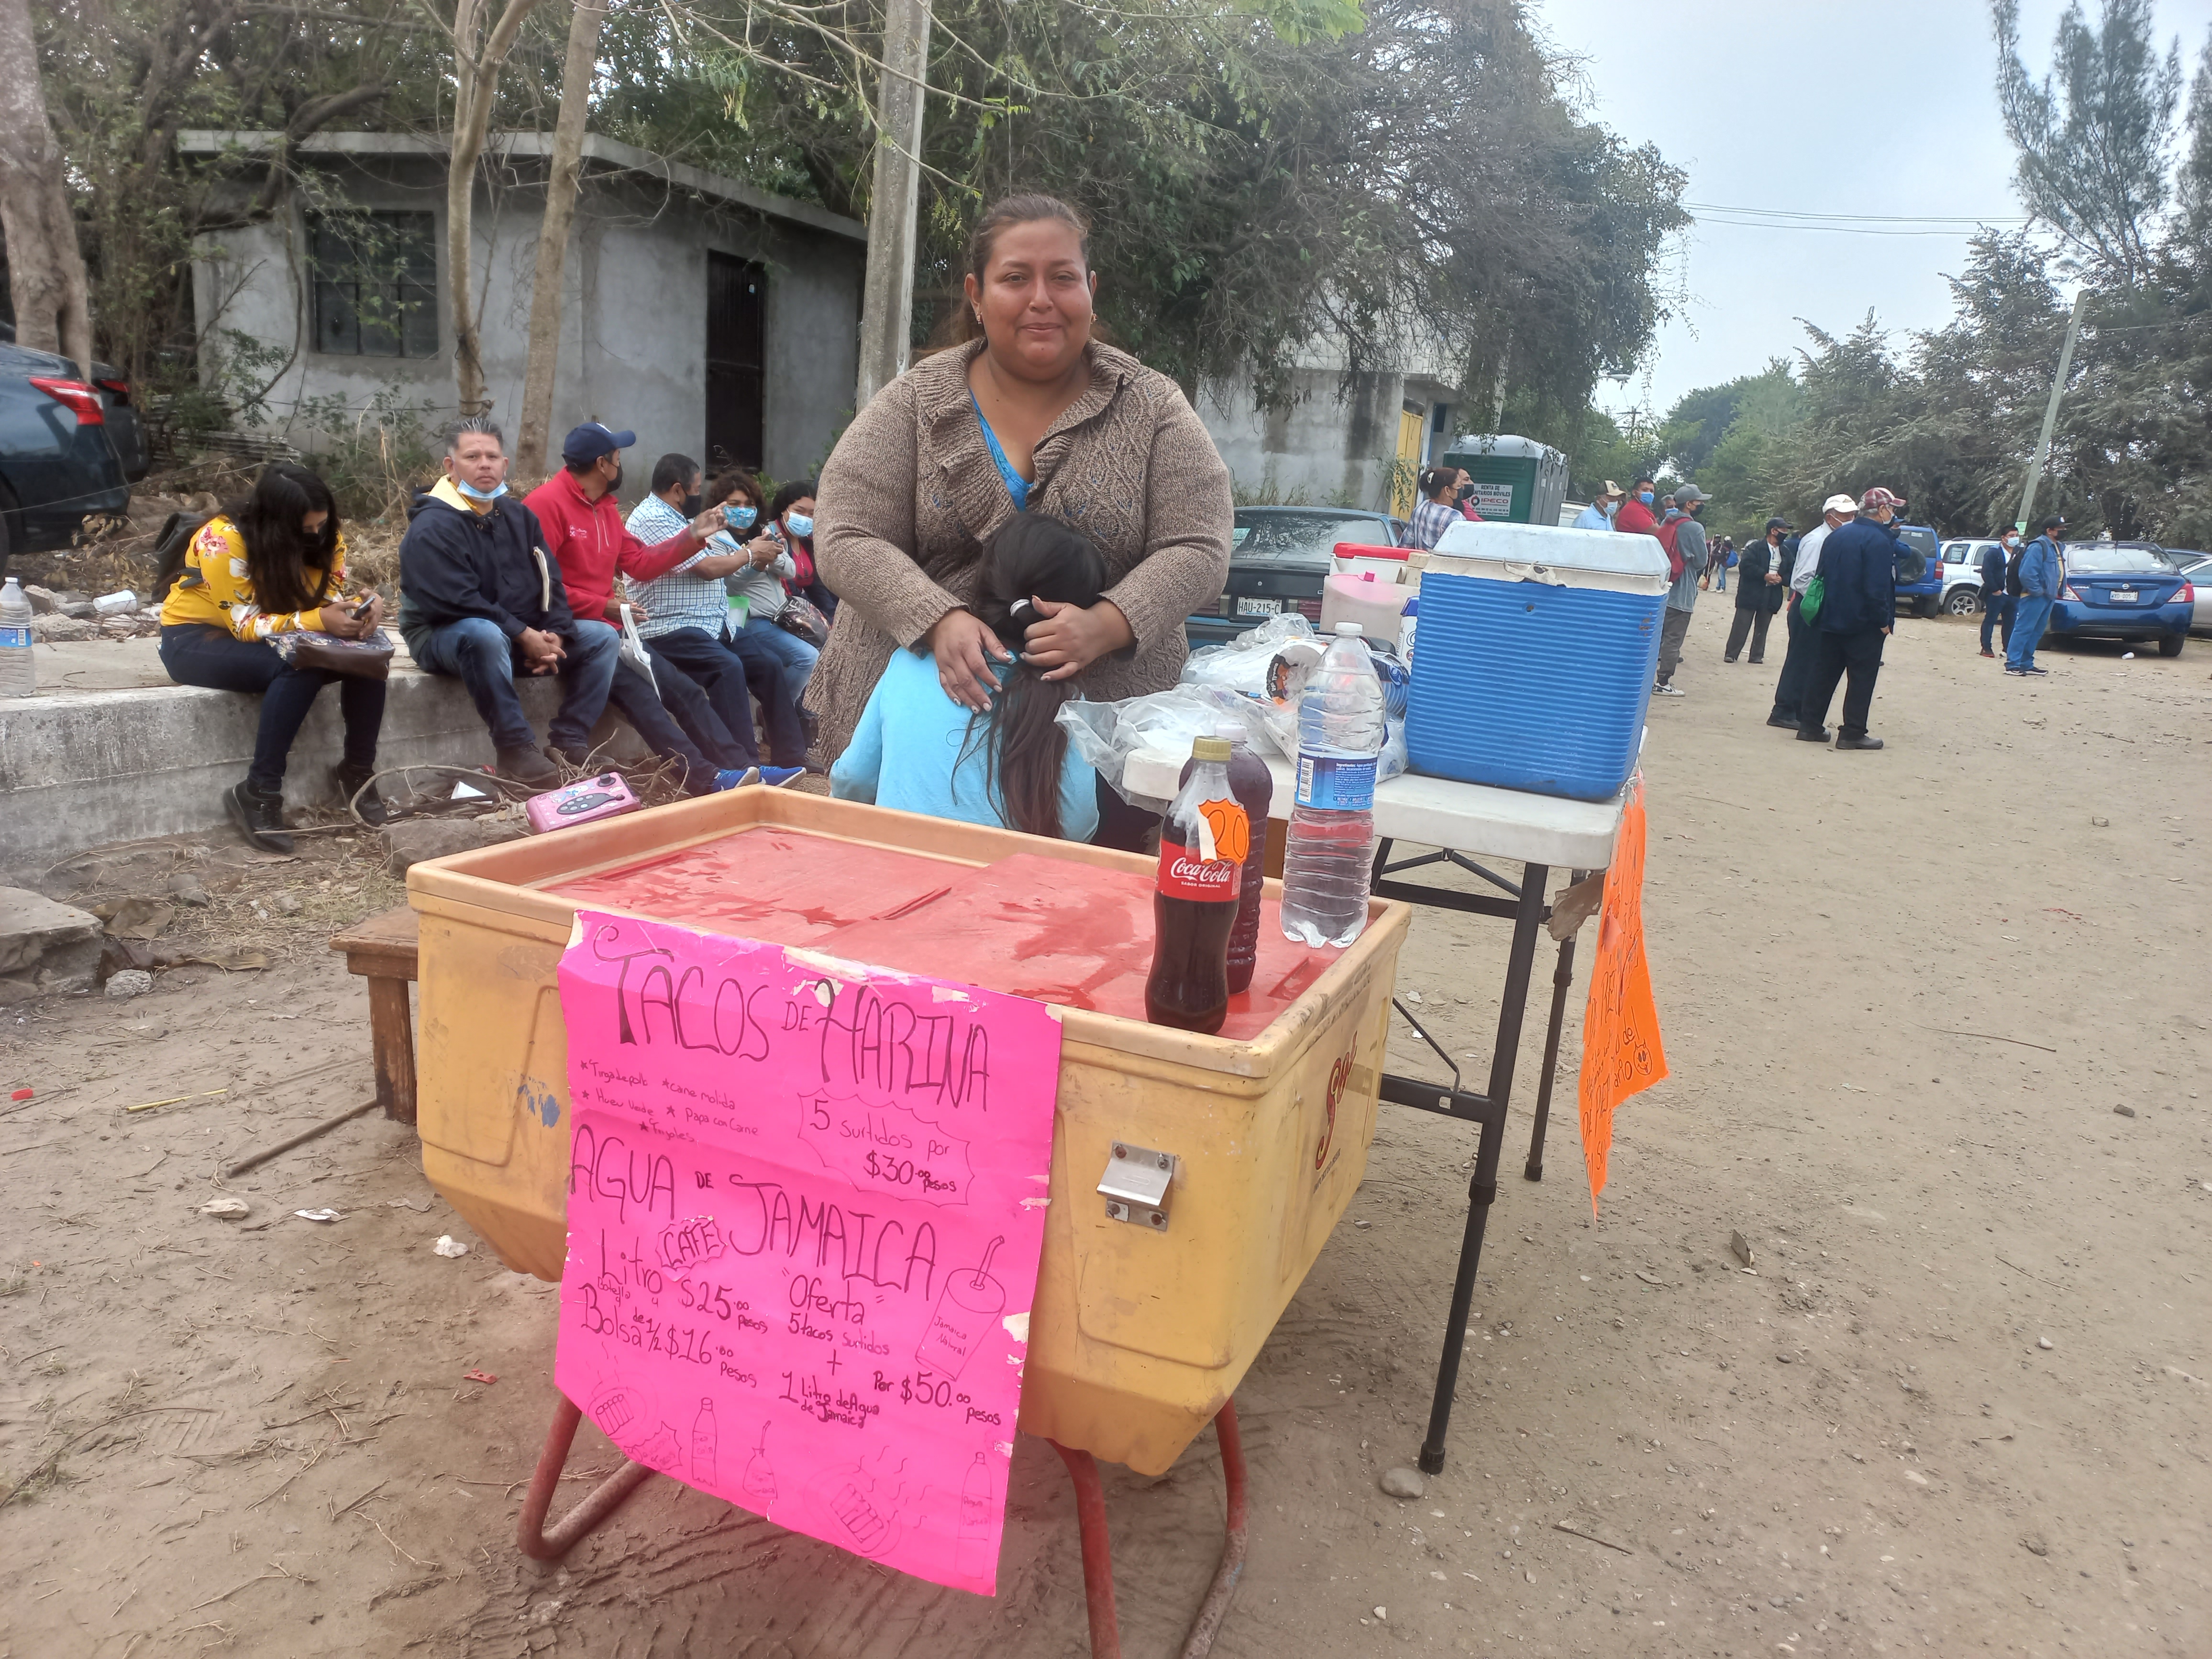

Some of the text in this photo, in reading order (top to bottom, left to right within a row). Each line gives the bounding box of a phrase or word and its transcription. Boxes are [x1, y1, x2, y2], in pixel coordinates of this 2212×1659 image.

[1238, 599, 1280, 615] HAU-215-C
[1170, 857, 1233, 883] Coca-Cola
[592, 925, 990, 1112] TACOS DE HARINA
[809, 1099, 830, 1130] 5
[571, 1123, 936, 1301] AGUA DE JAMAICA
[601, 1228, 663, 1294] Litro
[578, 1282, 642, 1348] Bolsa
[632, 1306, 645, 1324] de
[934, 1316, 967, 1340] Jamaica
[778, 1370, 799, 1403] 1
